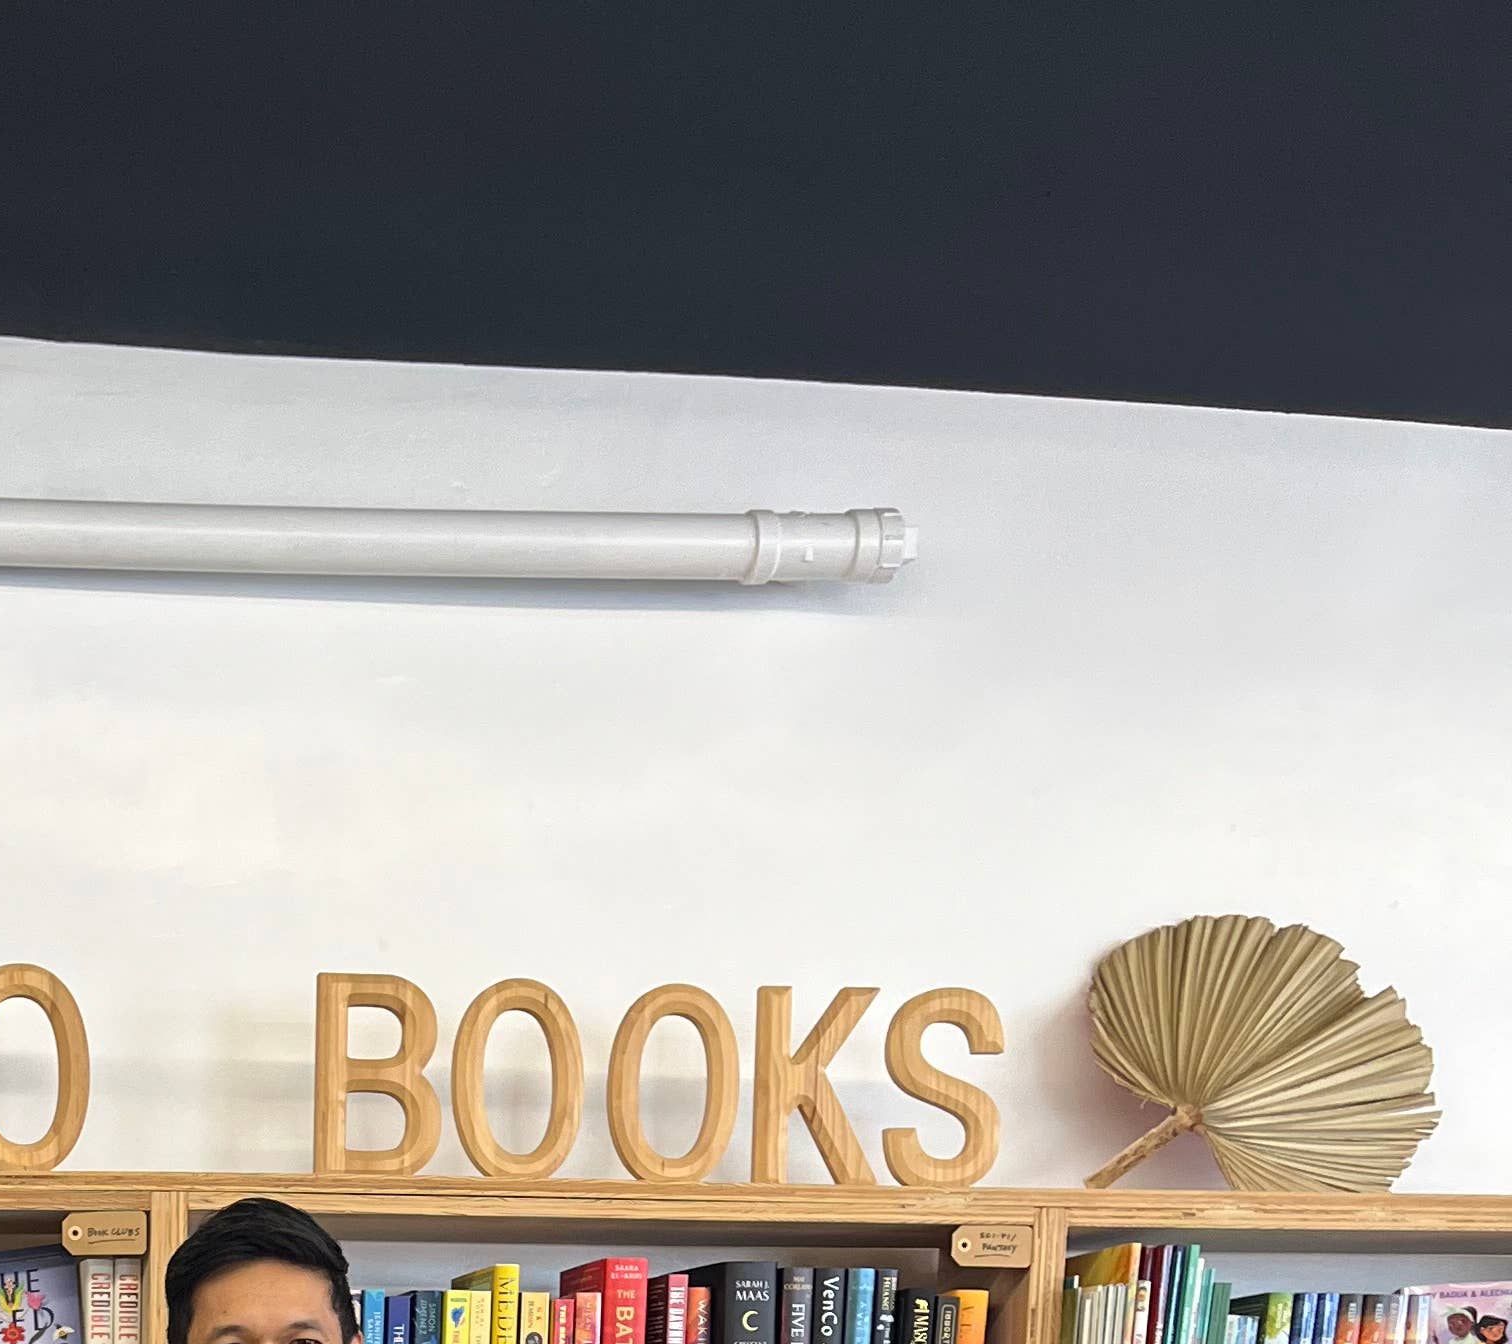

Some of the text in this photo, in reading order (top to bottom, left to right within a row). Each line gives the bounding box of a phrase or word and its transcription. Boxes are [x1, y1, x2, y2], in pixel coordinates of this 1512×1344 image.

[314, 971, 1004, 1187] BOOKS
[736, 1290, 770, 1301] MAAS
[791, 1304, 806, 1338] FIVE
